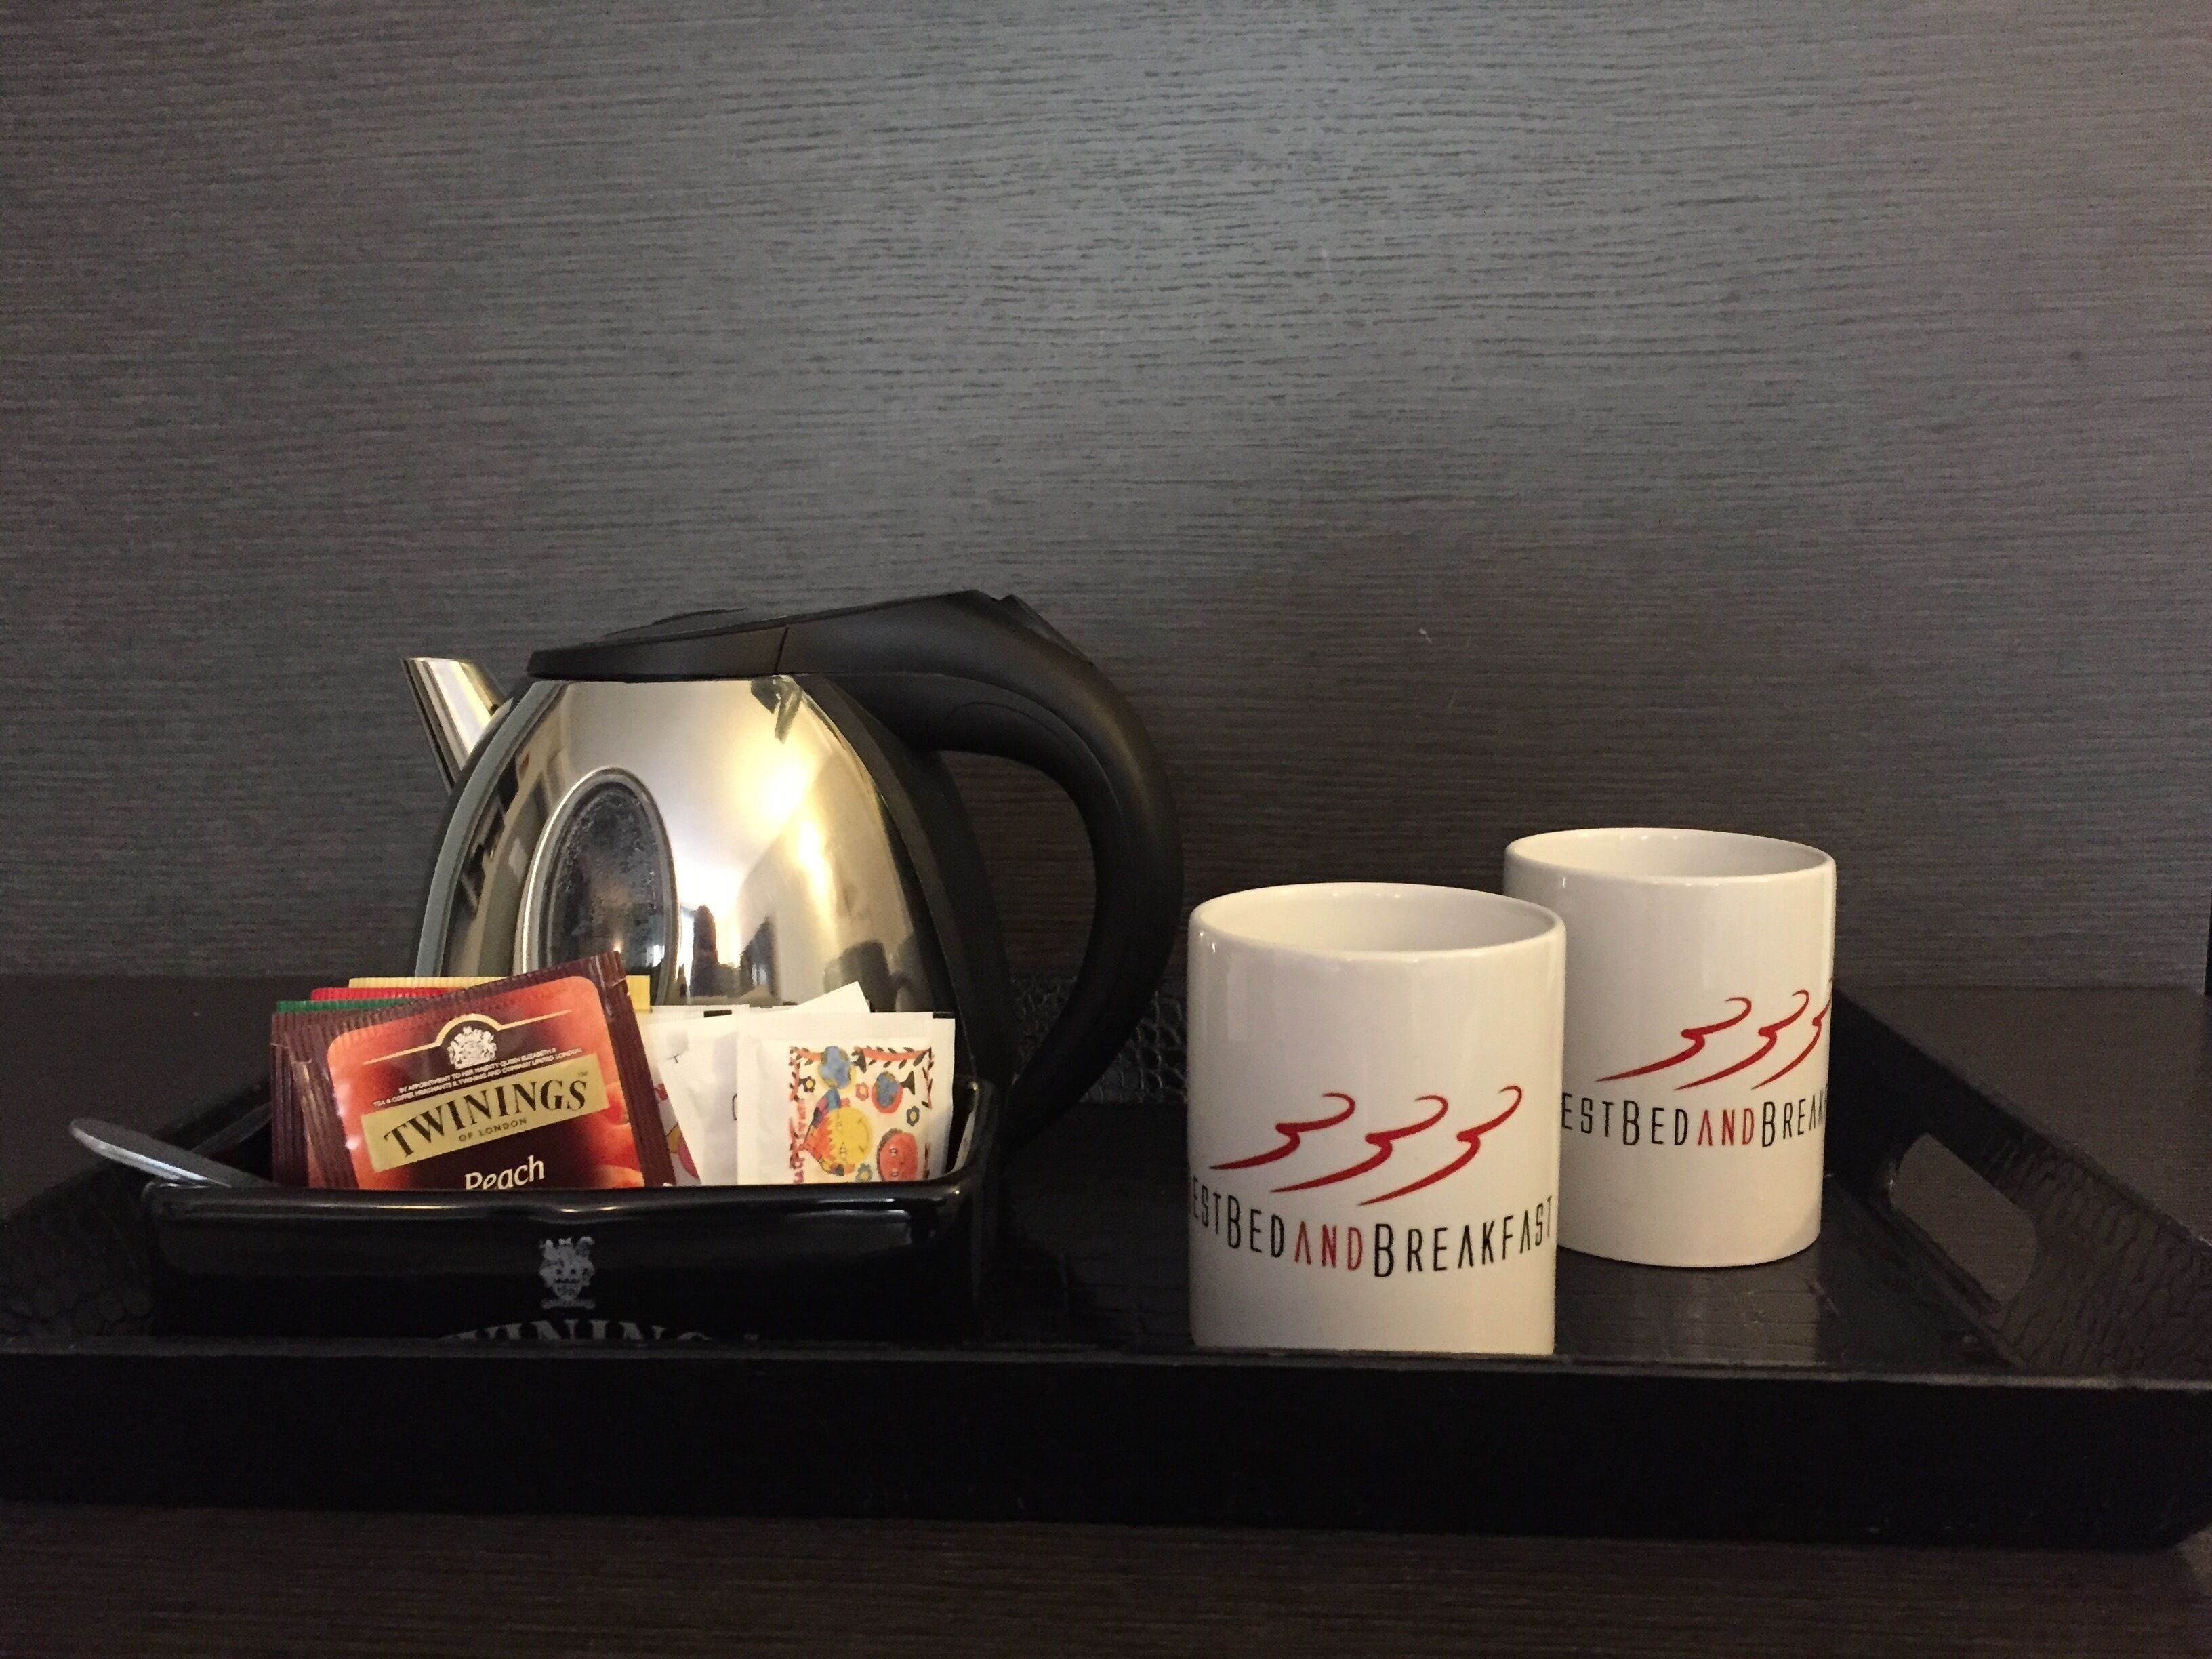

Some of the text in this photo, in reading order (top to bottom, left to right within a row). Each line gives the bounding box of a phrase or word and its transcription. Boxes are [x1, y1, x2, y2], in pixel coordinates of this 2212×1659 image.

[384, 1079, 588, 1158] TWININGS
[458, 1117, 527, 1142] OF LONDON
[465, 1155, 545, 1191] Peach
